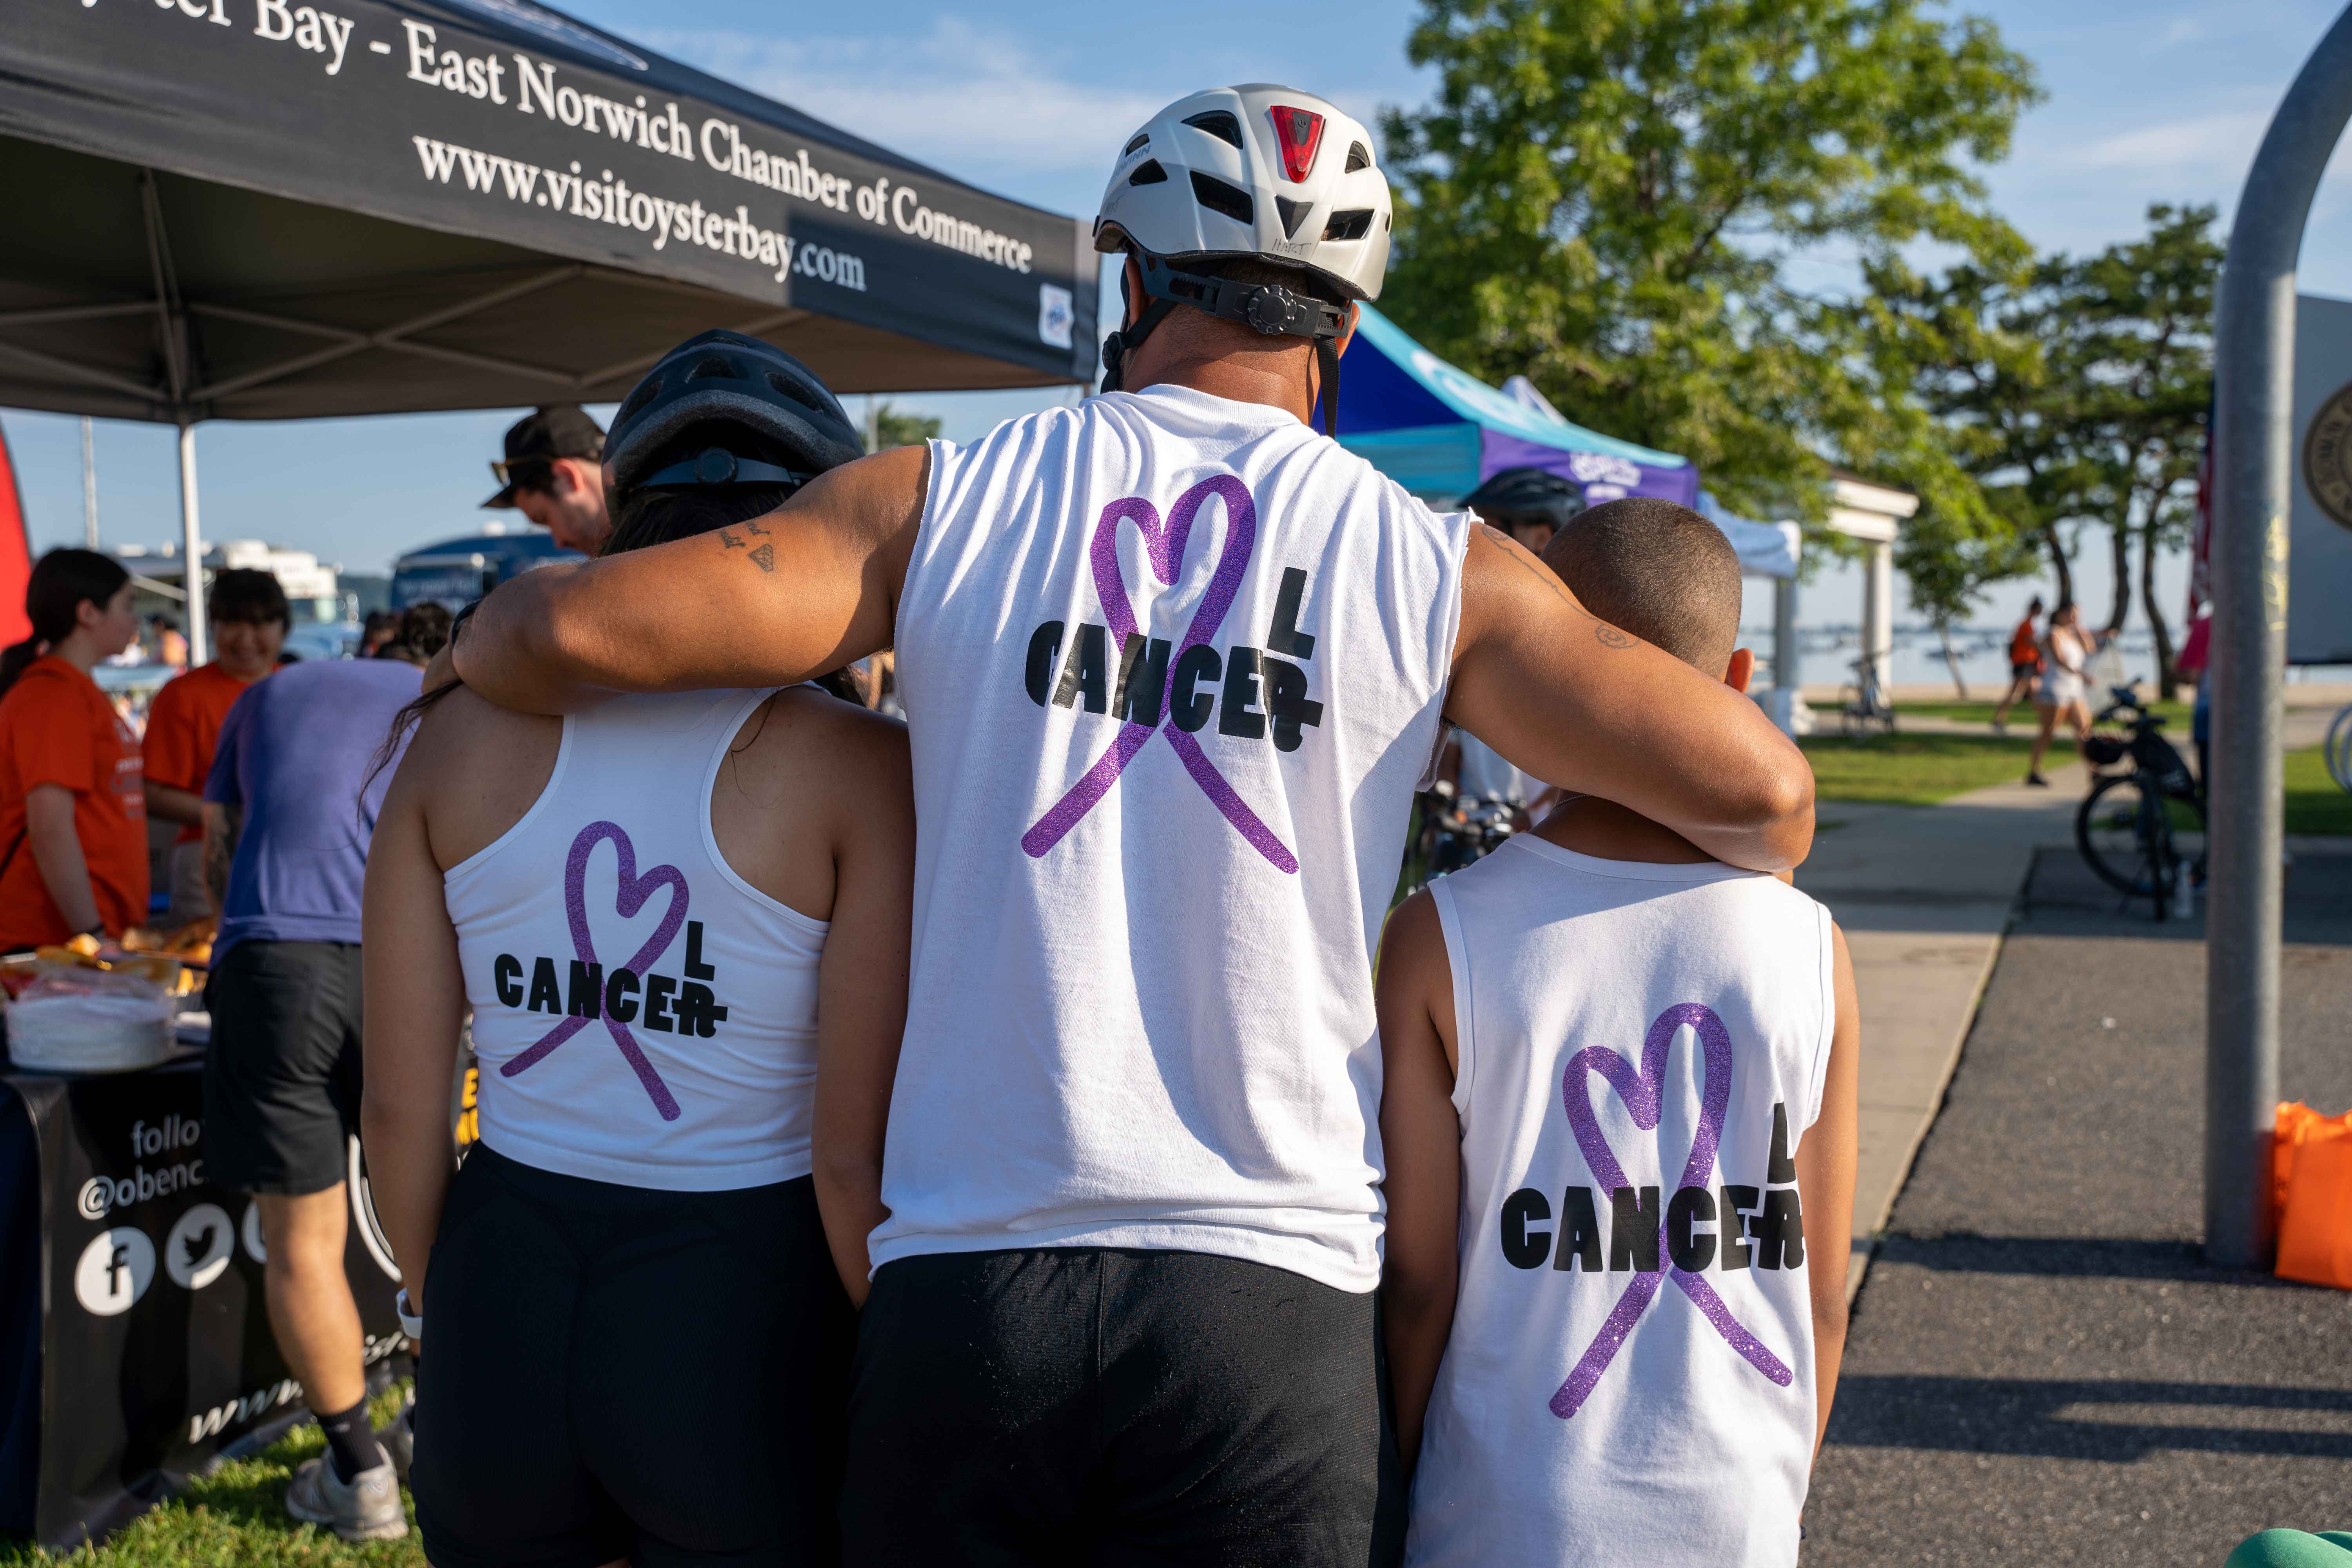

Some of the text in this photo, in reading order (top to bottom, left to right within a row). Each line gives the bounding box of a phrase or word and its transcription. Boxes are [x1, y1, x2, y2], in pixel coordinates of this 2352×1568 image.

[254, 0, 355, 76] Bay
[401, 18, 508, 105] East
[514, 53, 696, 161] Norwich
[700, 118, 851, 213] Chamber
[855, 176, 889, 227] of
[892, 187, 1033, 275] Commerce
[412, 135, 867, 291] www.visitoysterbay.com
[494, 953, 728, 1038] CANCER
[131, 1113, 201, 1159] follo
[78, 1159, 205, 1220] @obenc
[1501, 1185, 1804, 1272] CANCER
